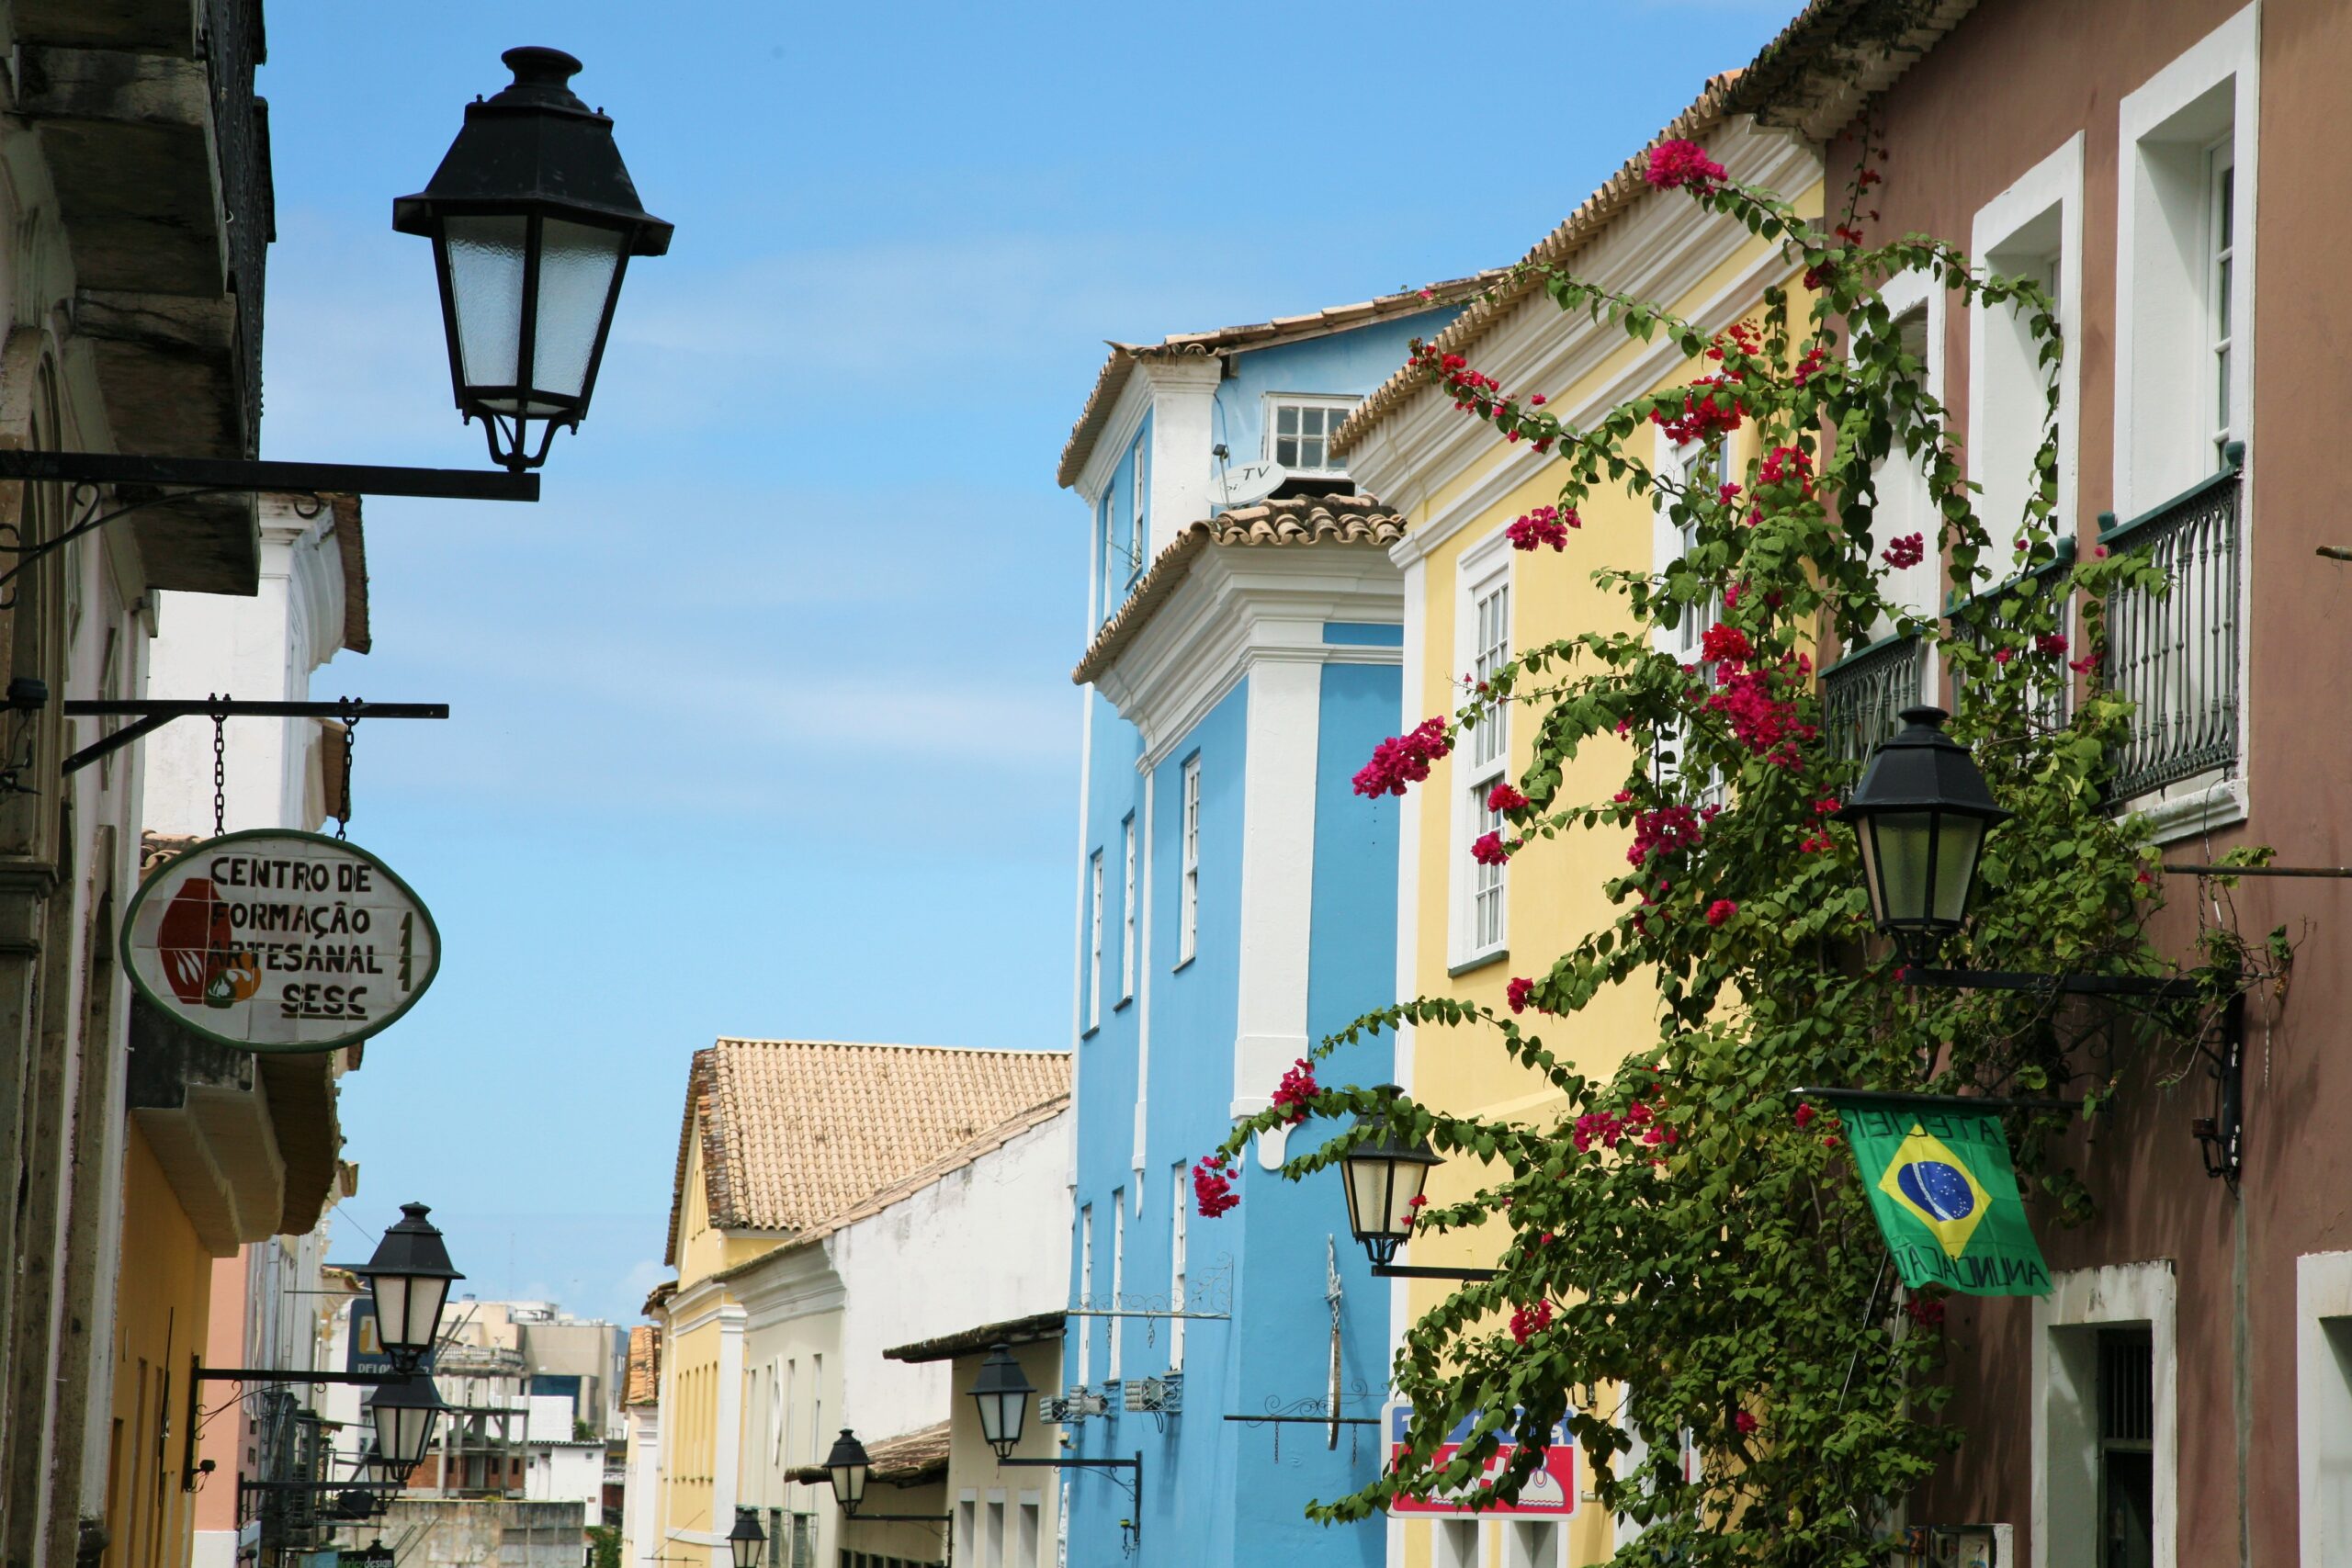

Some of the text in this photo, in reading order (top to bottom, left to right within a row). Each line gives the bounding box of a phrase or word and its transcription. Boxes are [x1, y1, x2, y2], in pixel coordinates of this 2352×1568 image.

[1242, 465, 1270, 481] TV
[210, 856, 372, 893] CENTRO DE
[211, 900, 371, 940] FORMAÇÃO
[208, 940, 384, 975] ARTESANAL
[279, 983, 368, 1015] SESC
